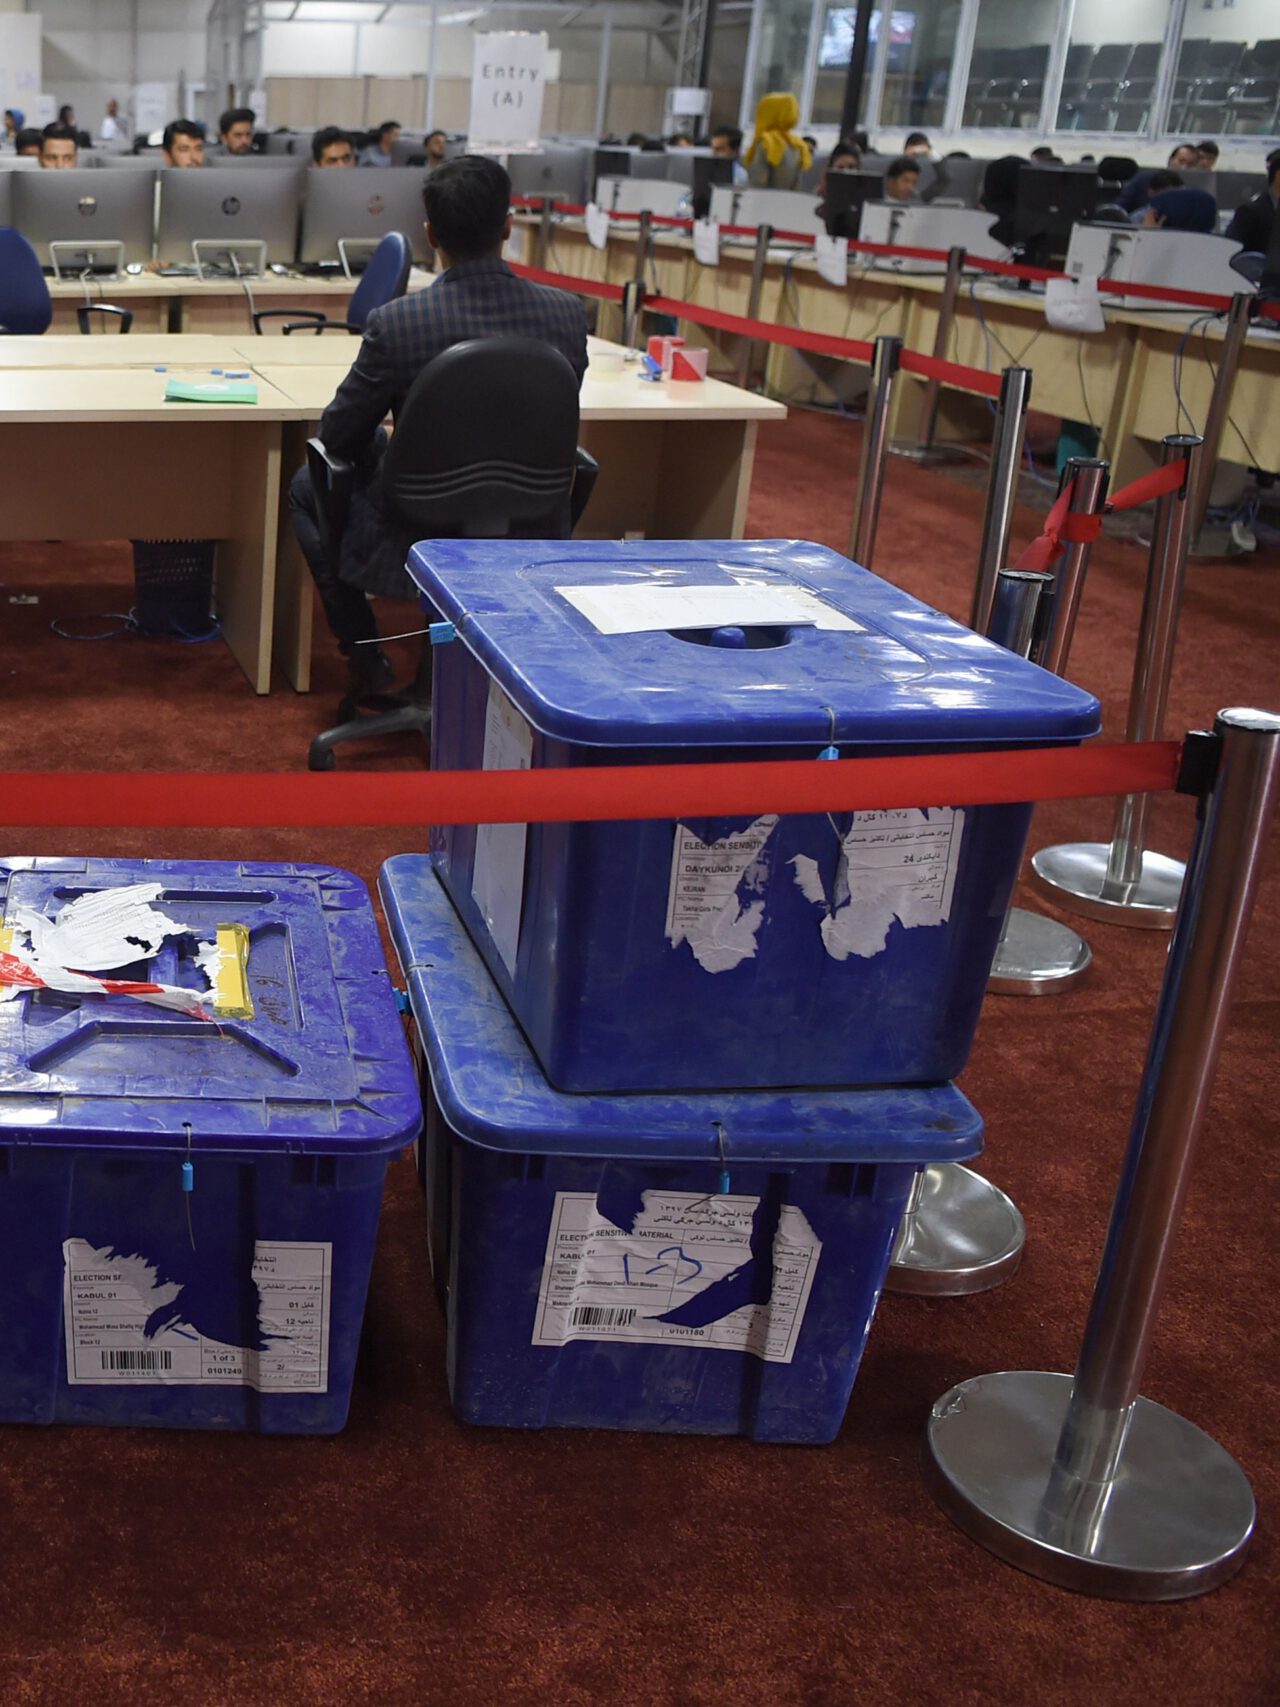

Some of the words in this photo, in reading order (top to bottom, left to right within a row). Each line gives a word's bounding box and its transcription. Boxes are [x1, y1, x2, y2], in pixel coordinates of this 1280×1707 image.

[482, 64, 539, 83] Entry
[492, 90, 524, 109] (A)
[903, 854, 914, 864] 24
[685, 865, 733, 874] DAYKUNDI
[73, 1274, 111, 1282] ELECTION
[288, 1301, 299, 1309] 01
[285, 1317, 296, 1325] 12
[79, 1338, 94, 1346] Block
[207, 1367, 242, 1375] 0101249
